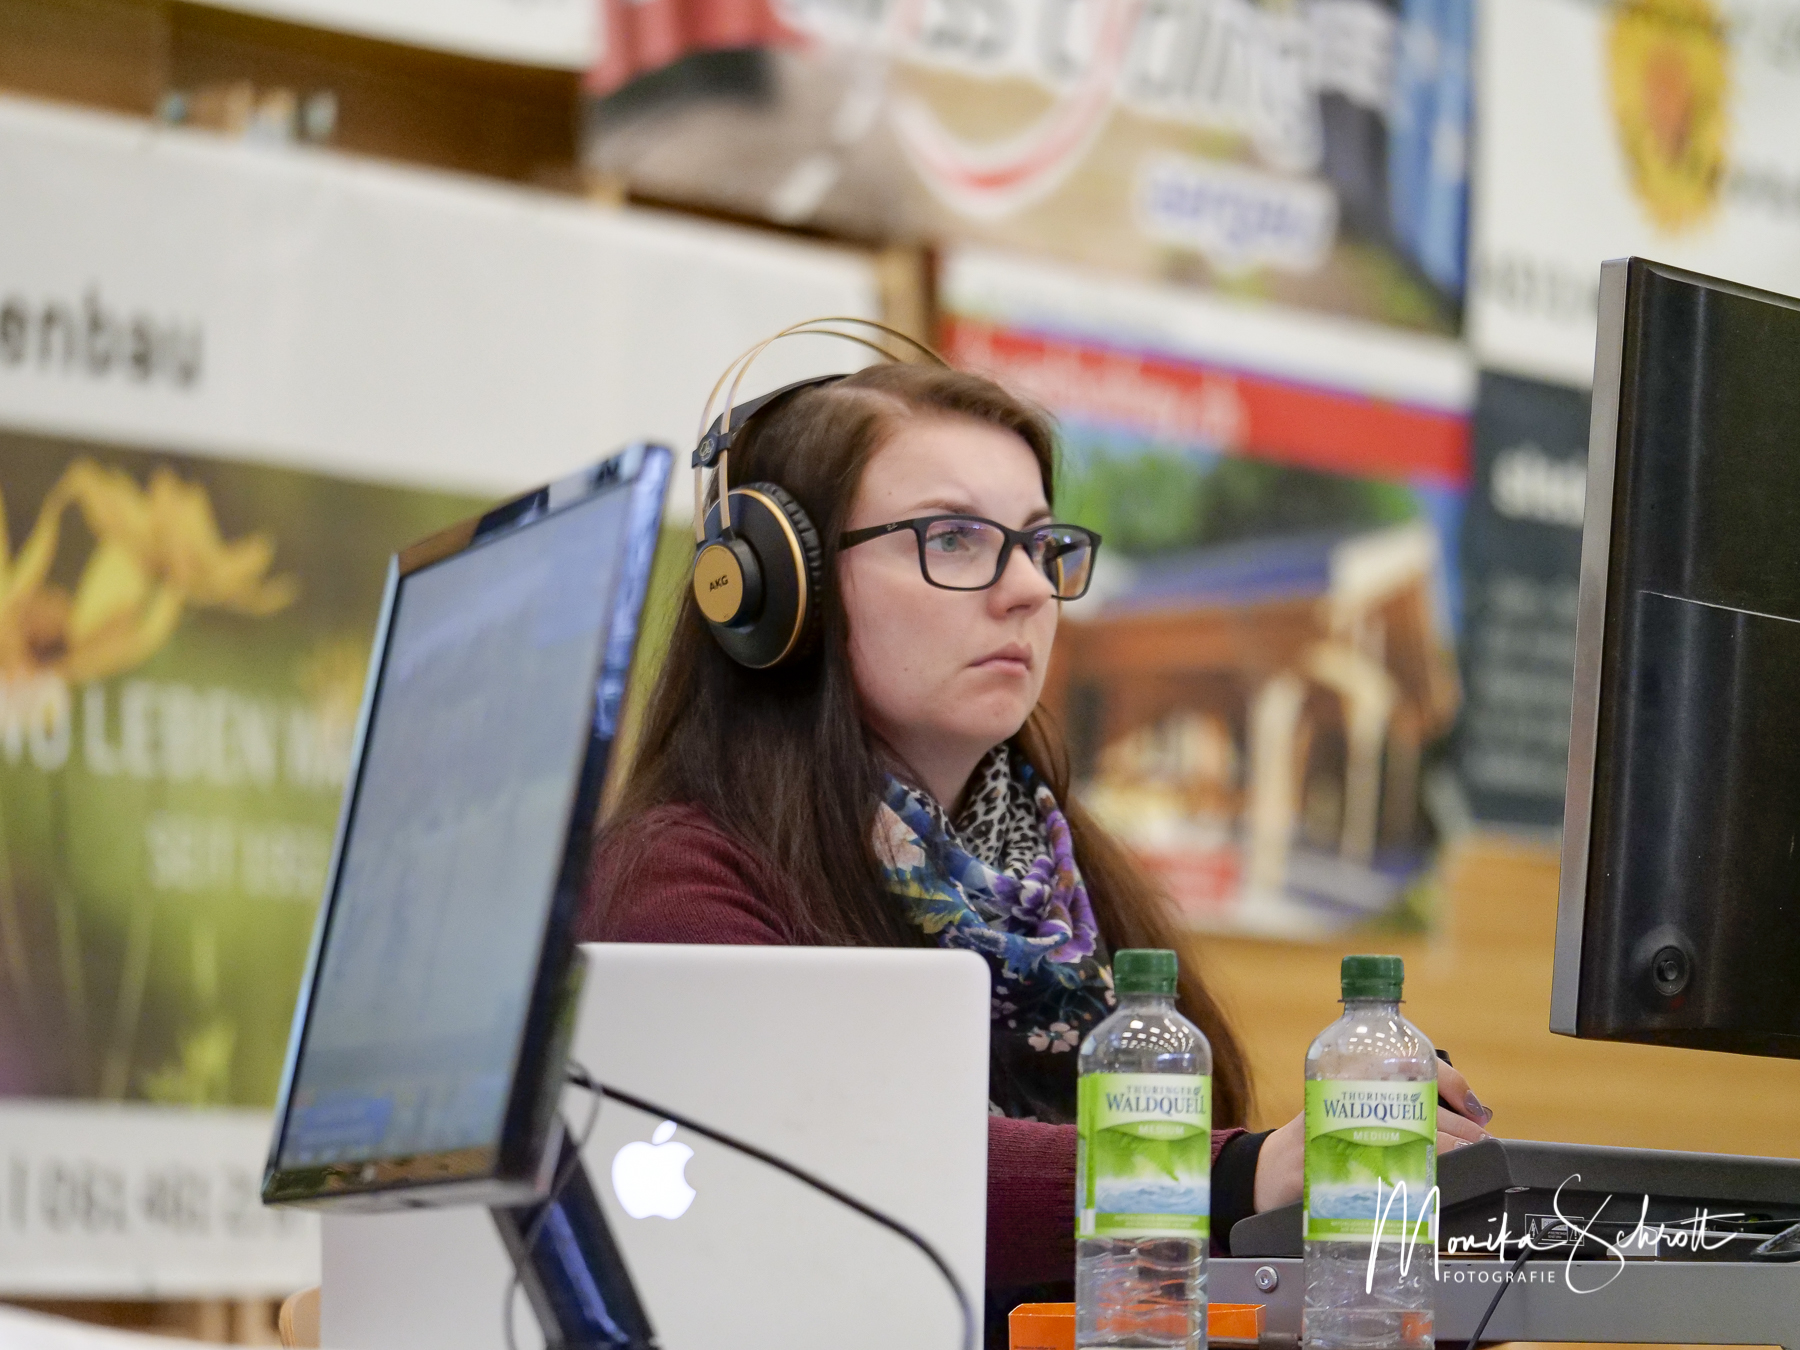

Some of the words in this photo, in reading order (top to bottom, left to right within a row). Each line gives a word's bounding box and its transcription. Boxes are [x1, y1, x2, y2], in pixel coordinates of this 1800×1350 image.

[709, 574, 729, 592] AKG
[1106, 1092, 1206, 1116] WALDQUELL
[1324, 1098, 1427, 1123] WALDQUELL
[1353, 1131, 1400, 1141] MEDIUM
